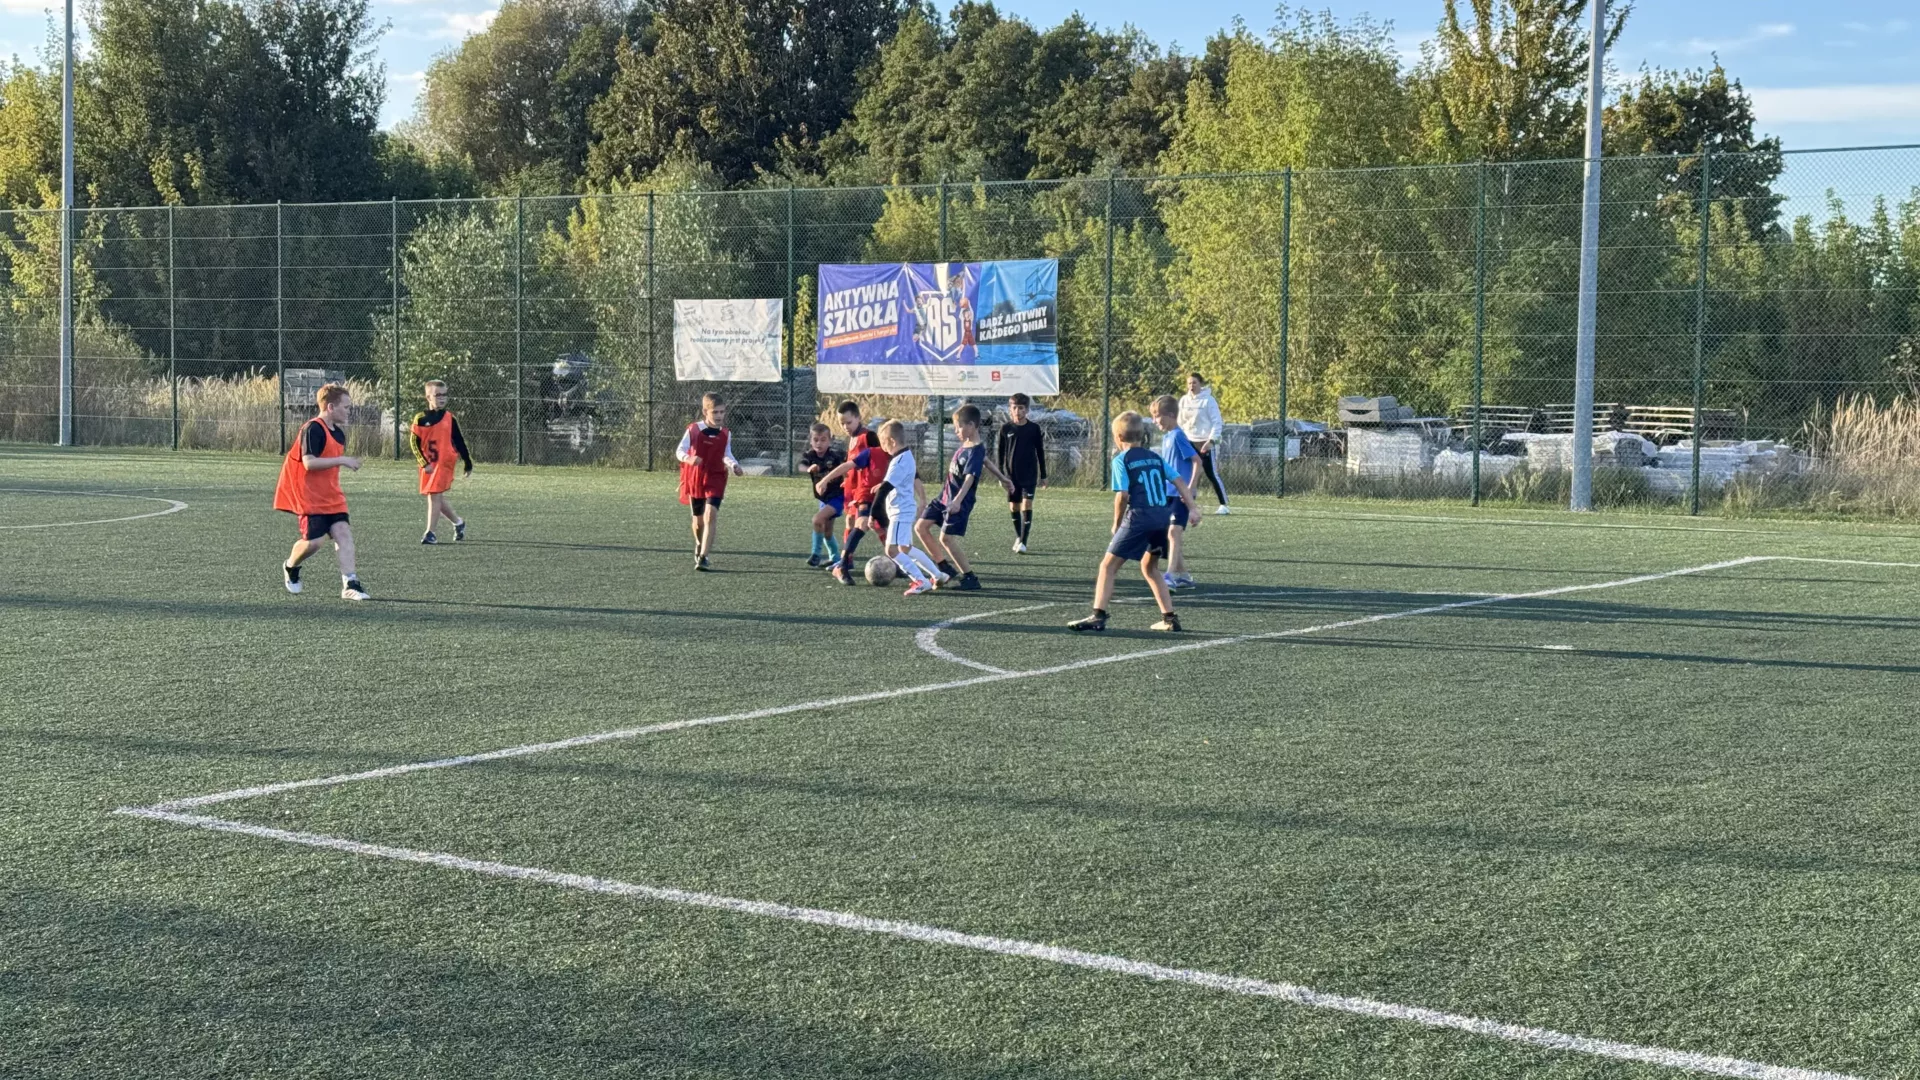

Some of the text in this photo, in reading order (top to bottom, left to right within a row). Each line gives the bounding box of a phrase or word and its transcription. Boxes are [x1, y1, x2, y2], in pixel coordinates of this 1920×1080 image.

[824, 280, 899, 312] AKTYWNA
[824, 299, 898, 337] SZKOŁA
[980, 306, 1047, 330] BĄDŹ AKTYWNY
[980, 318, 1047, 341] KAŻDEGO DNIA!
[428, 440, 439, 462] 5
[1138, 469, 1167, 507] 10
